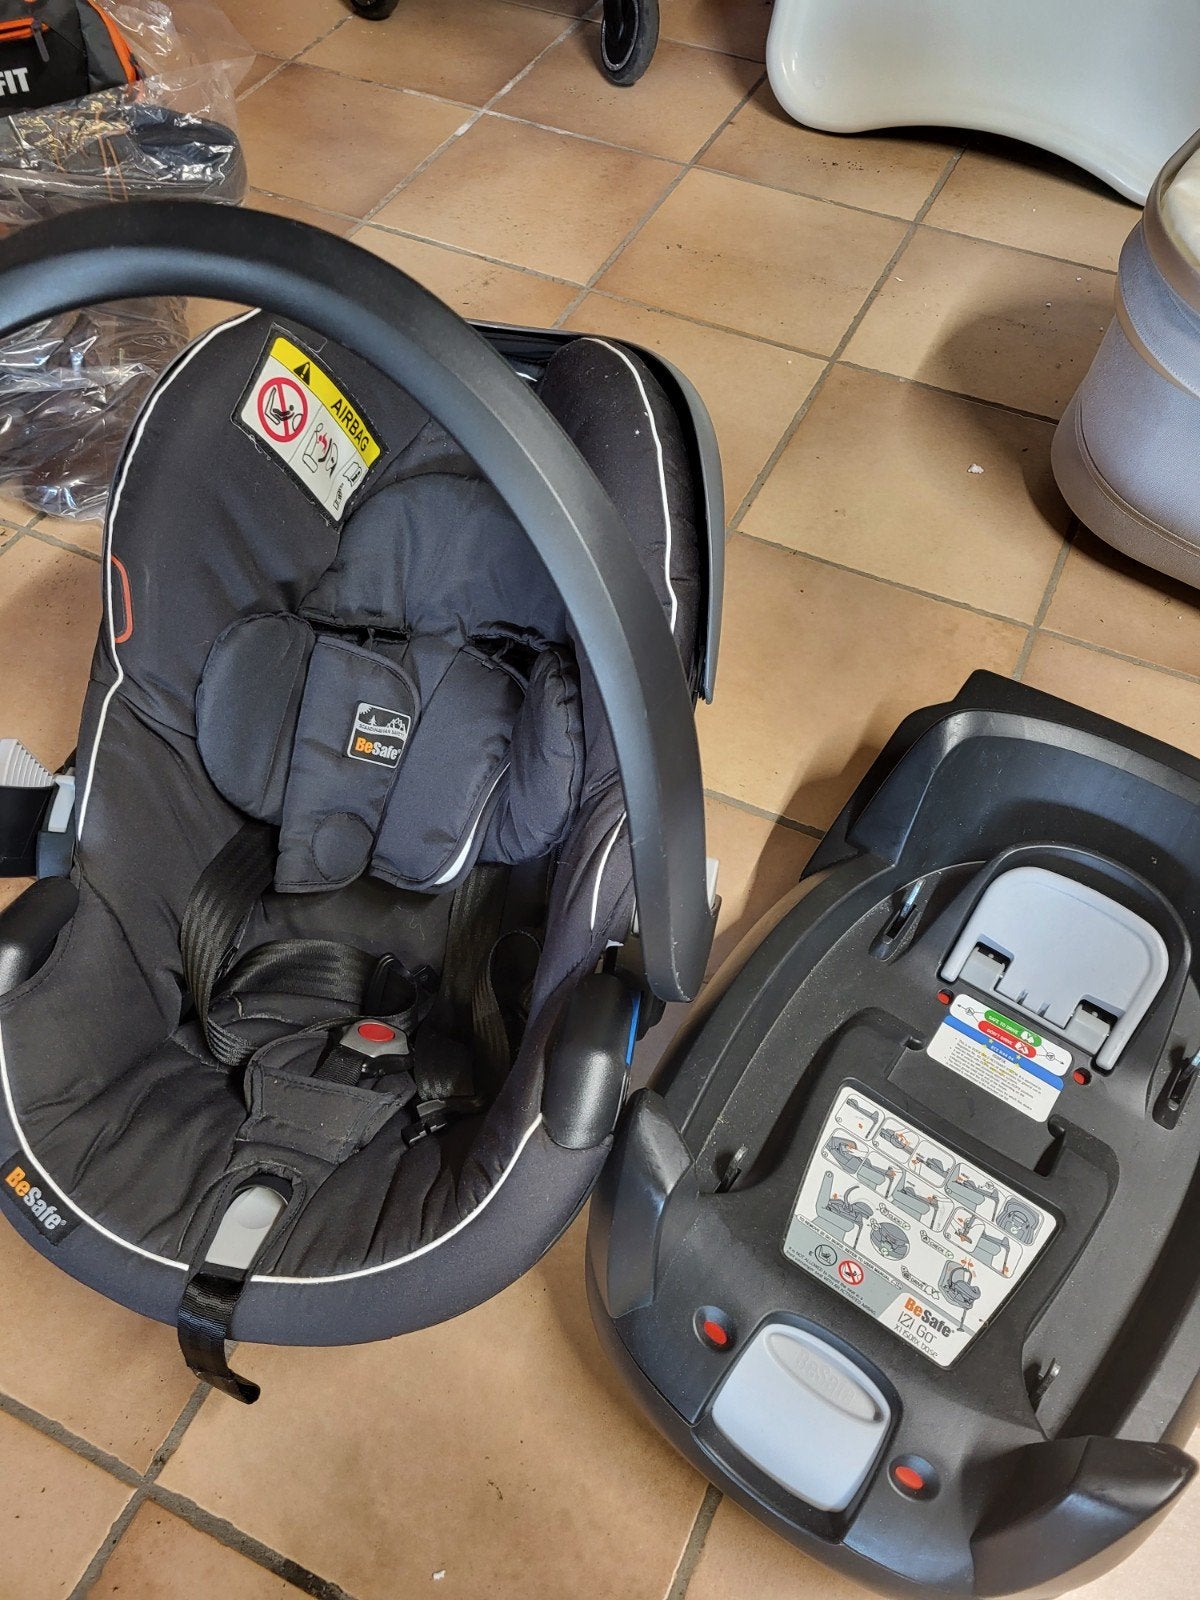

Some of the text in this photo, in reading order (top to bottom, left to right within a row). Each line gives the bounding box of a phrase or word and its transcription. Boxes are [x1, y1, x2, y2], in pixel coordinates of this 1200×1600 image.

[331, 398, 369, 451] AIRBAG
[988, 1015, 999, 1023] SAFE
[1005, 1024, 1018, 1035] DRIVE
[999, 1035, 1013, 1045] DRIVE
